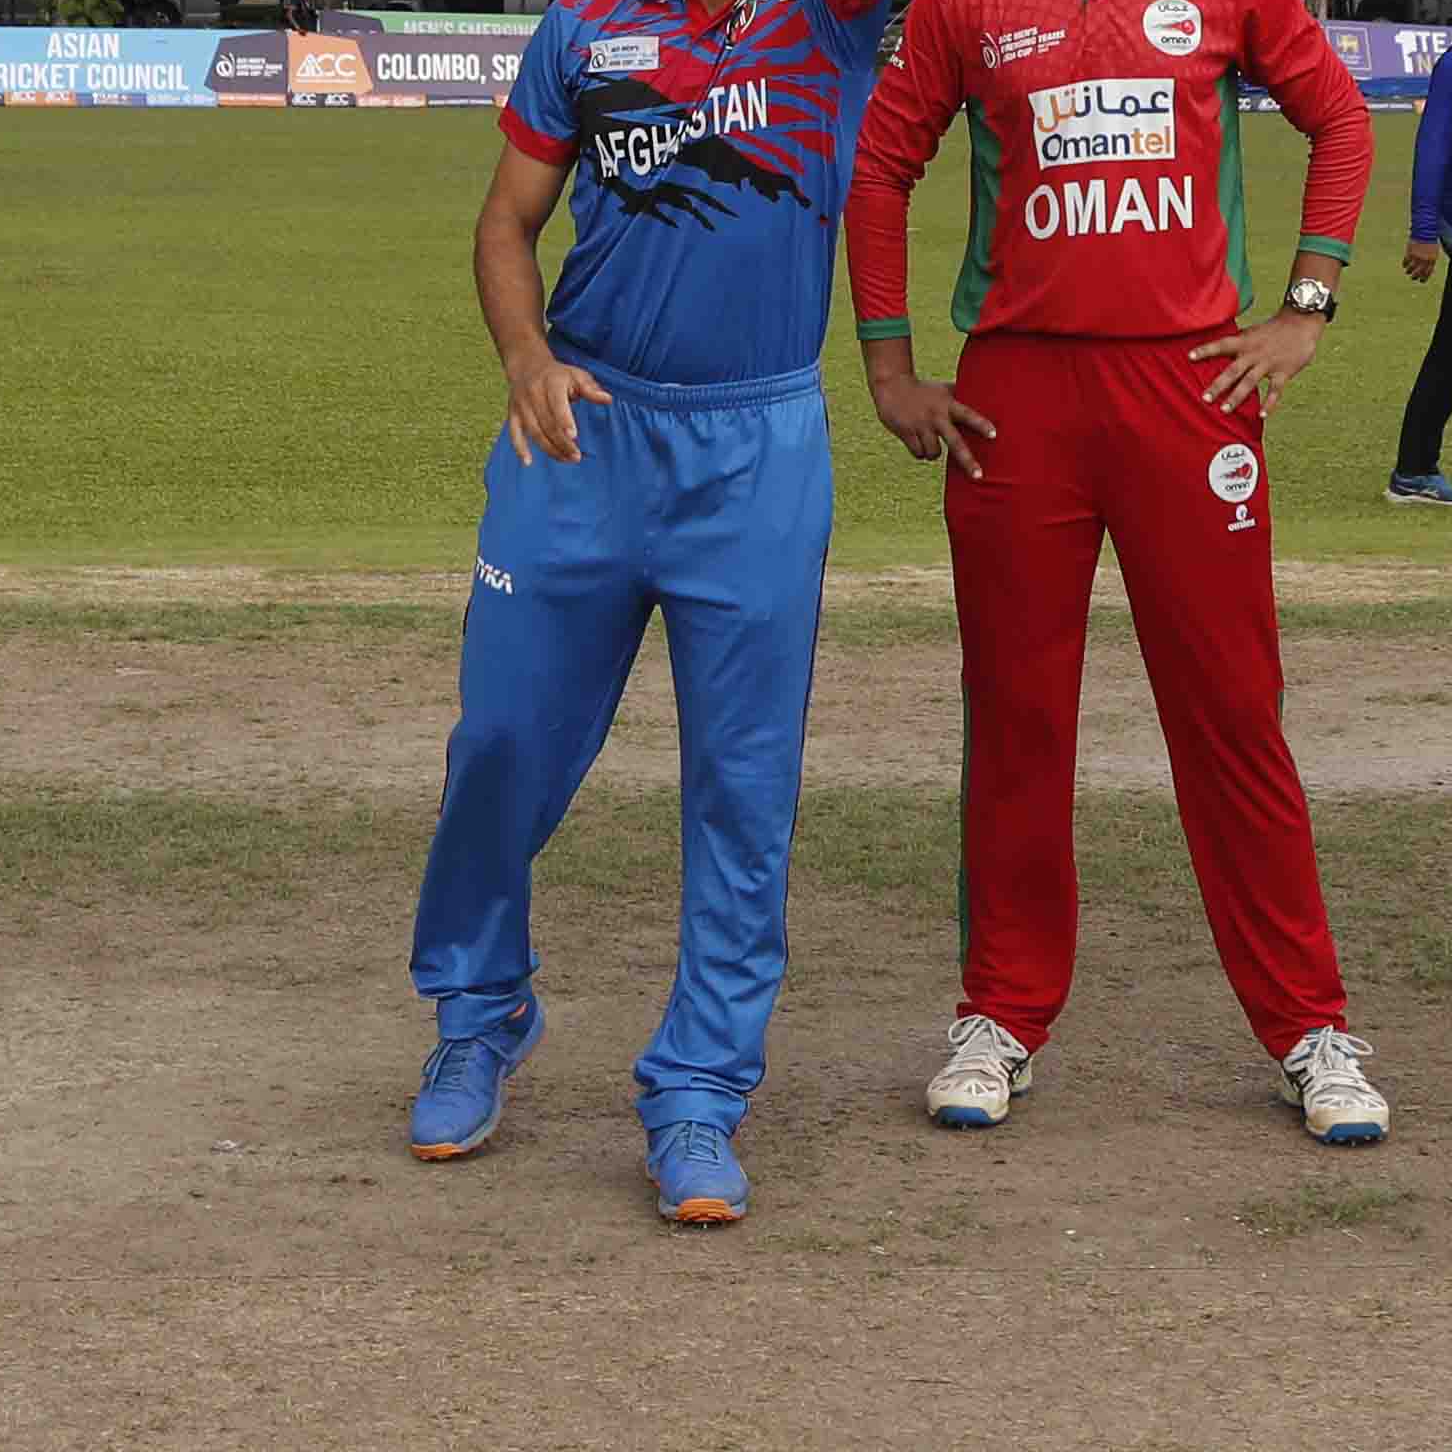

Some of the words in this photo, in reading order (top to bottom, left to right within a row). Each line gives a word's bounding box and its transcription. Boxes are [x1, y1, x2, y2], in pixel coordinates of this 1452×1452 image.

[48, 32, 120, 59] ASIAN
[86, 63, 189, 90] COUNCIL
[296, 53, 357, 77] ACC
[377, 53, 486, 85] COLOMBO,
[1036, 85, 1170, 133] عمانتل
[1041, 125, 1172, 162] Omantel
[1025, 174, 1194, 240] OMAN
